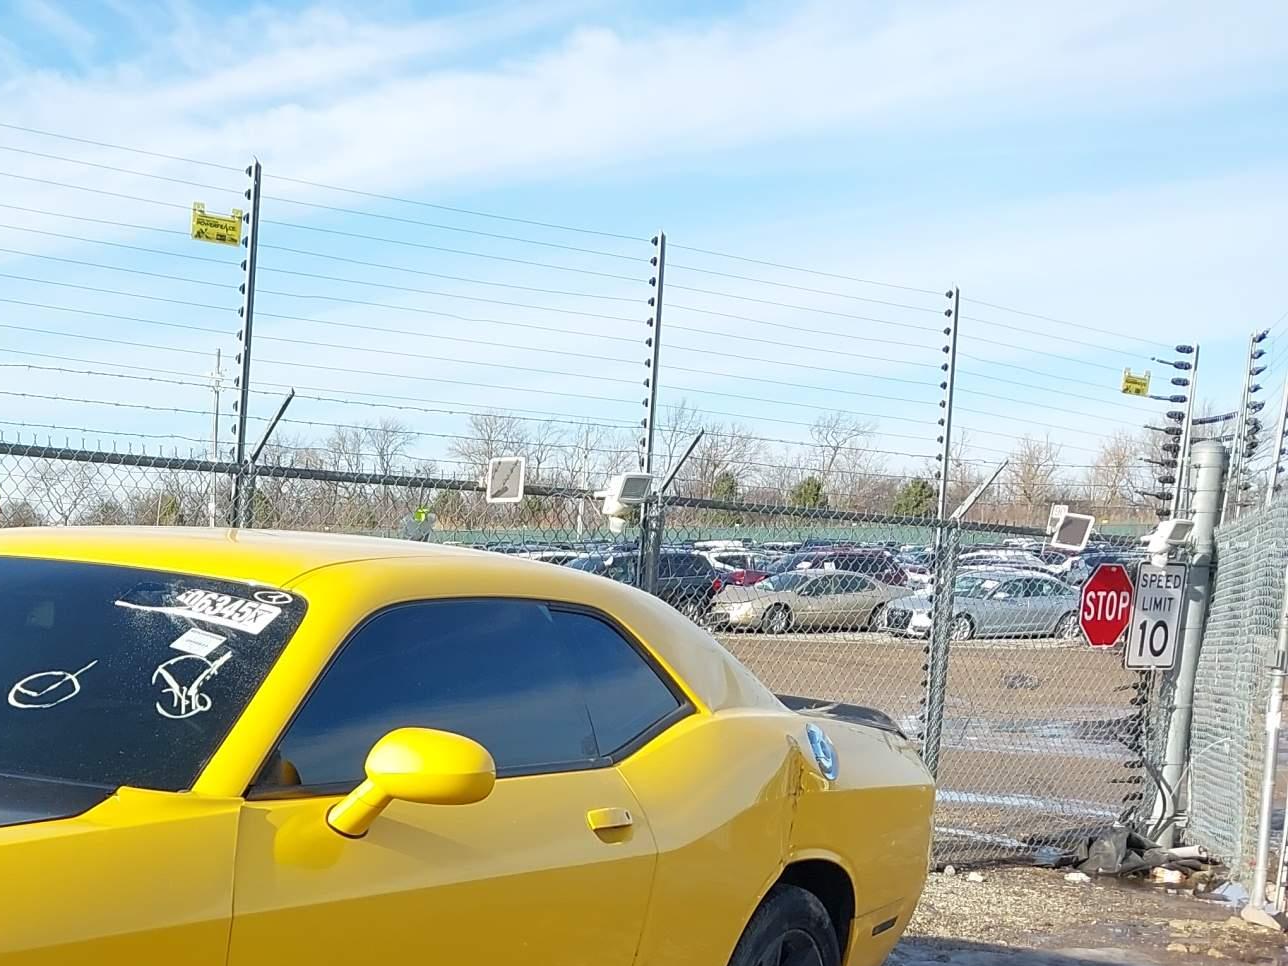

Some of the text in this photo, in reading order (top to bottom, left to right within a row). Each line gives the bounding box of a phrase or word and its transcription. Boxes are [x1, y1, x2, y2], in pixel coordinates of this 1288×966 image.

[1141, 574, 1182, 589] SPEED
[1083, 590, 1130, 621] STOP
[1142, 596, 1174, 612] LIMIT
[1138, 620, 1169, 657] 10
